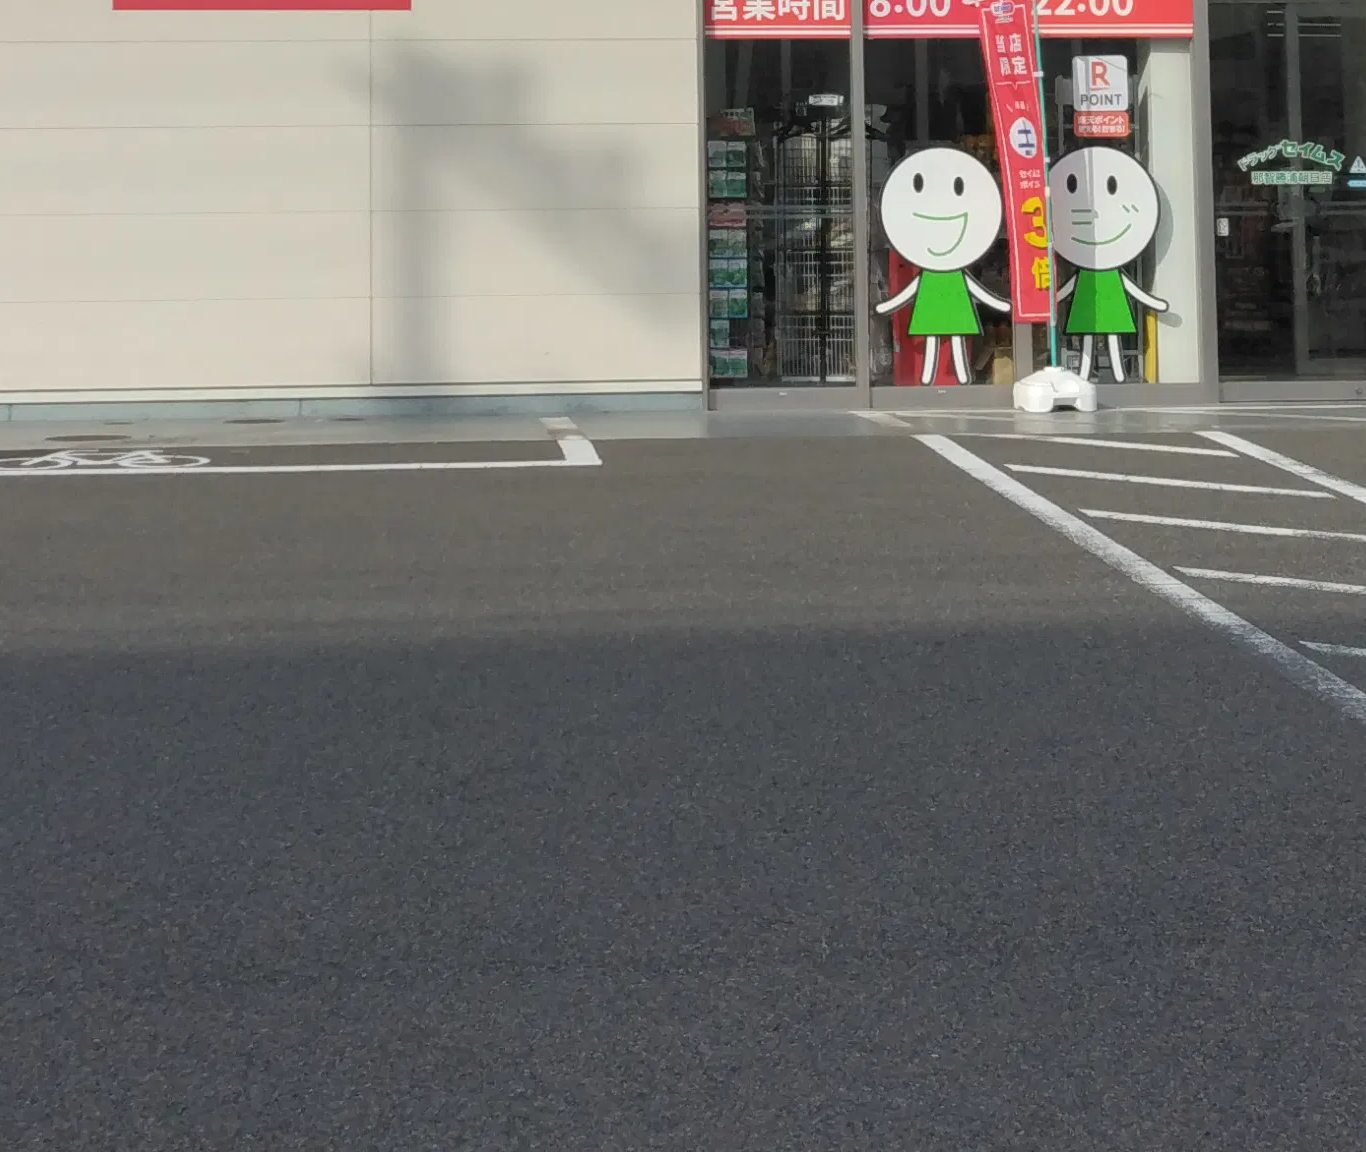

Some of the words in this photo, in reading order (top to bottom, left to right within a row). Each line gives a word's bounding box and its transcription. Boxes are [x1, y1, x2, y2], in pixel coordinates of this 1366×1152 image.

[995, 32, 1023, 54] 当店
[1080, 93, 1122, 106] POINT
[1279, 138, 1346, 172] セイムス
